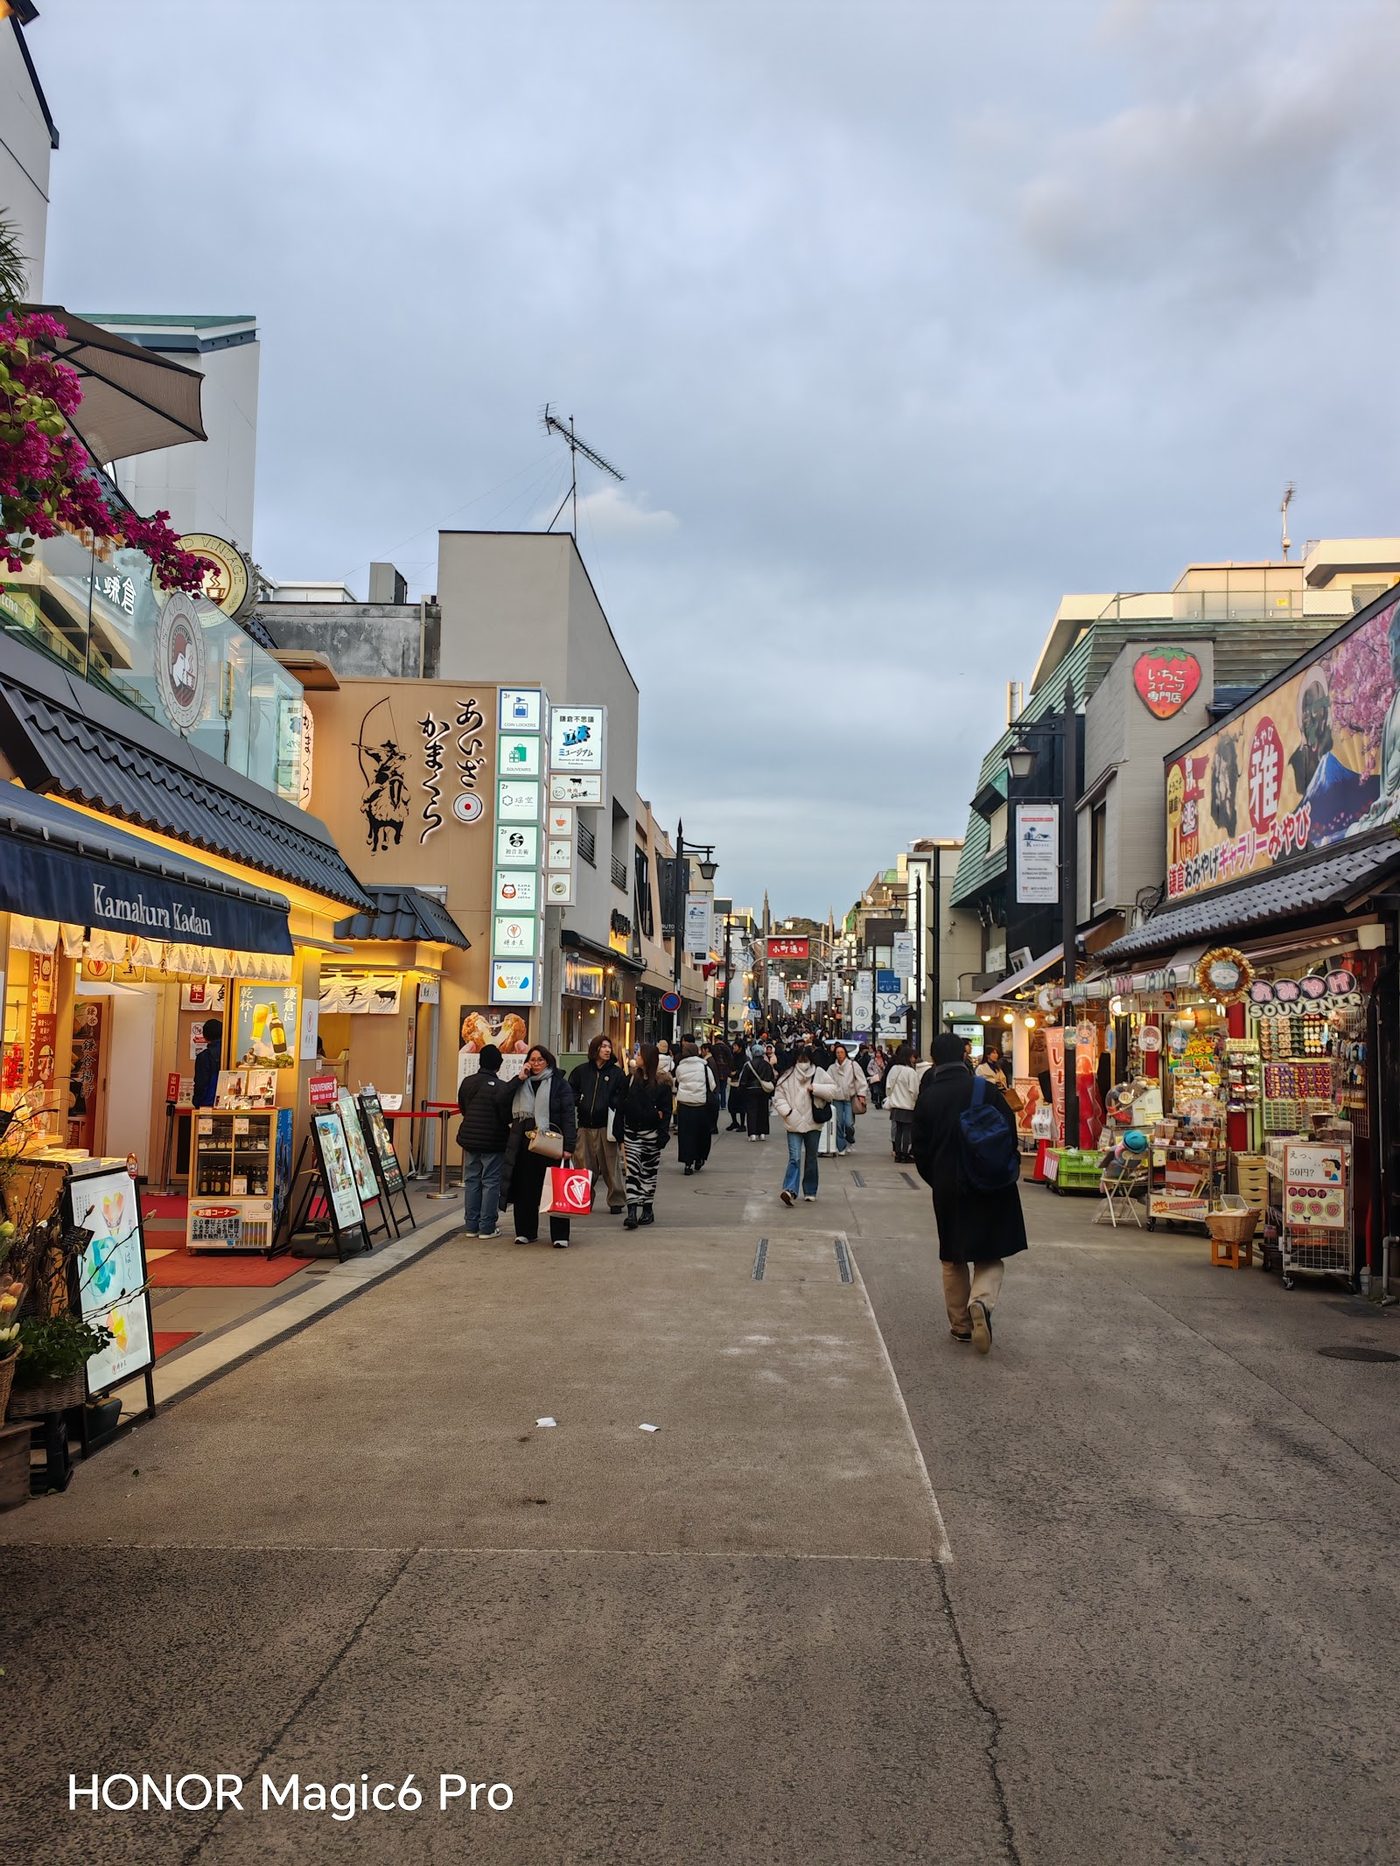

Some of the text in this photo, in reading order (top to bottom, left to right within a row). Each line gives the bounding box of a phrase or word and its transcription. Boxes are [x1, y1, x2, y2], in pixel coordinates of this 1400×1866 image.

[201, 536, 245, 586] VINTAGE
[1148, 669, 1187, 682] いちご
[1148, 682, 1184, 691] スイーツ
[1148, 691, 1182, 703] 専門店
[456, 698, 486, 788] あいざ
[417, 712, 451, 844] かまくら
[1249, 744, 1278, 824] 雅
[93, 884, 212, 936] Kamakura Kadan
[772, 946, 804, 954] 小町通り
[32, 989, 38, 1000] &
[1250, 972, 1350, 1003] おみやげ
[284, 988, 296, 1021] 鎌倉に
[1249, 993, 1363, 1018] SOUVENIR
[28, 1002, 37, 1077] SOUVENIRS
[310, 1082, 332, 1092] SOUVENIRS
[1290, 1168, 1314, 1177] 50円?
[198, 1208, 236, 1216] お酒コーナー
